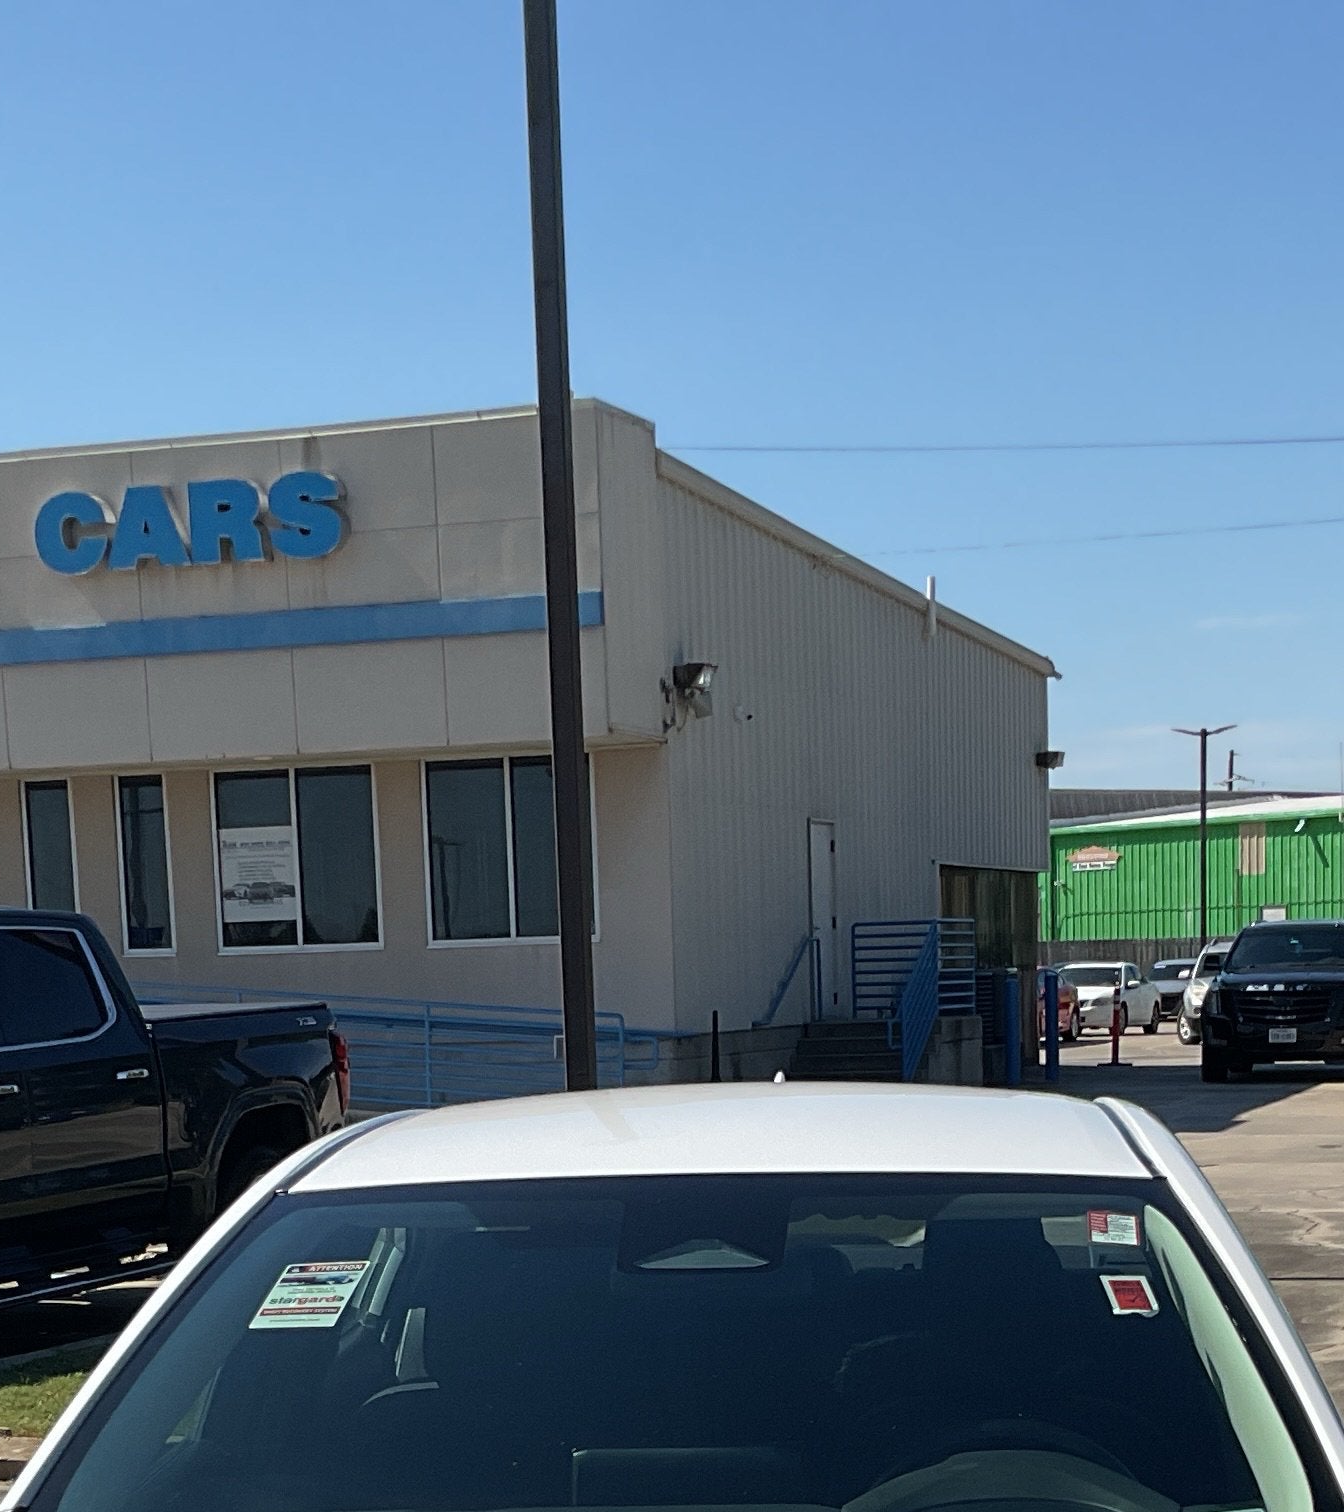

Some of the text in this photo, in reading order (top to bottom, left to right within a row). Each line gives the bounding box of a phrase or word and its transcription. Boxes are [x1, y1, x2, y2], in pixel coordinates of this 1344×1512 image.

[35, 470, 342, 576] CARS
[309, 1264, 363, 1272] ATTENTION
[268, 1295, 336, 1305] stargard
